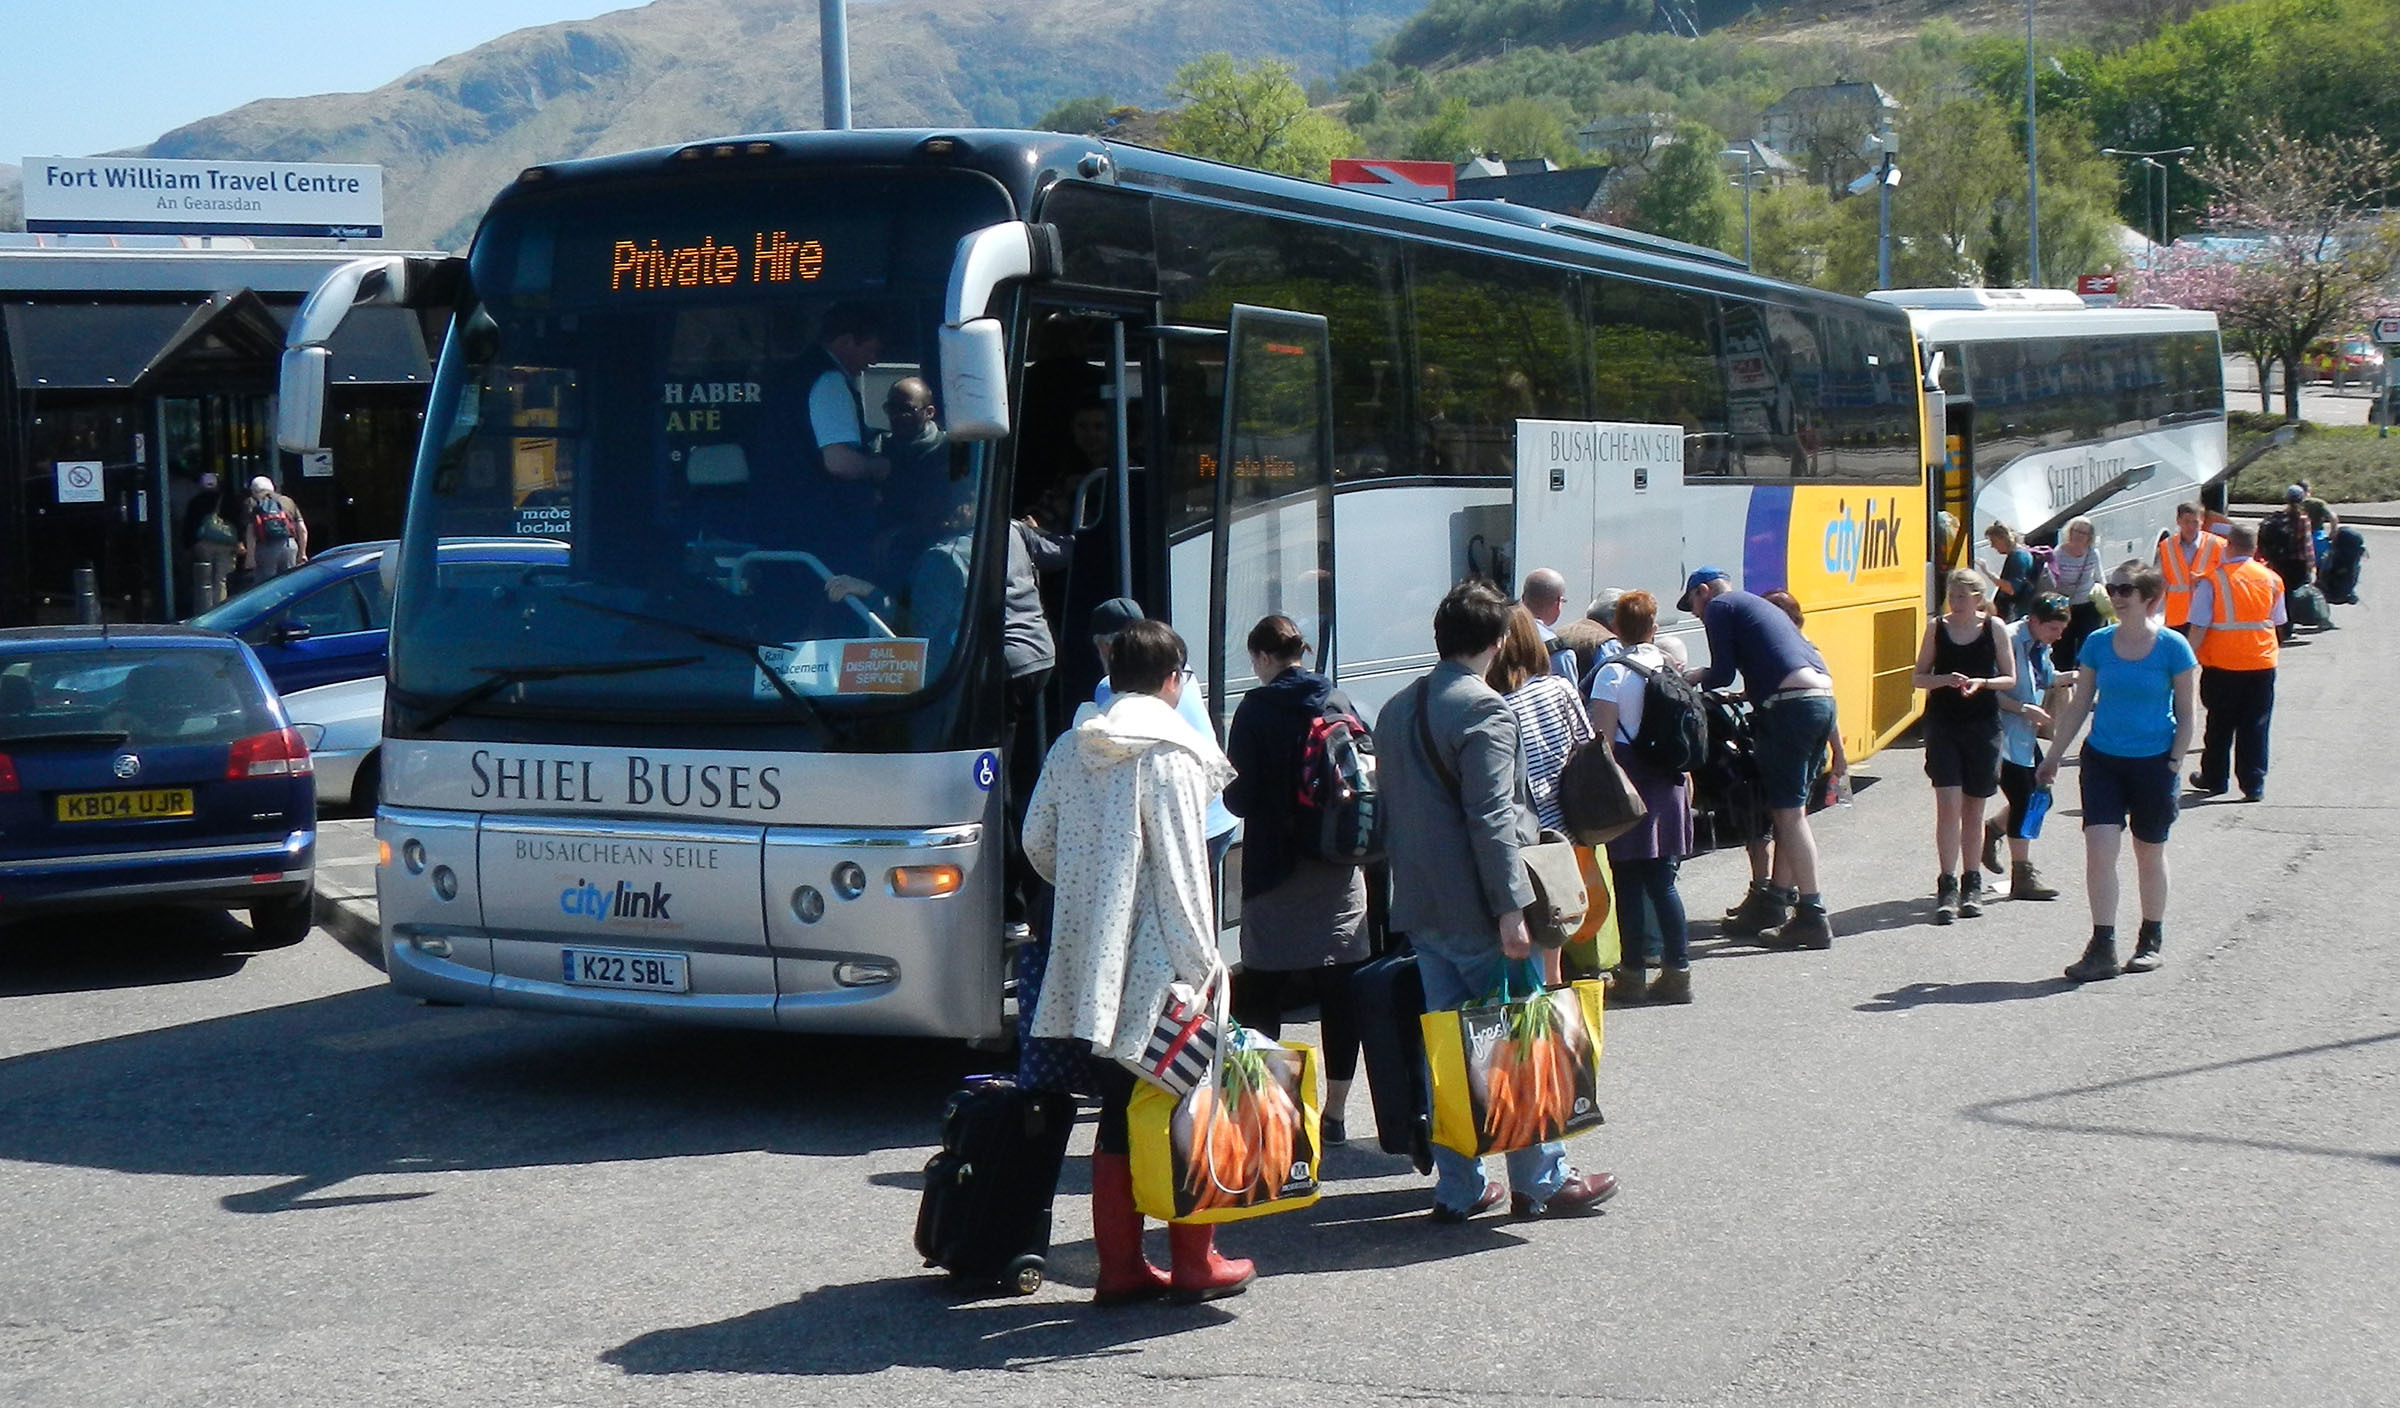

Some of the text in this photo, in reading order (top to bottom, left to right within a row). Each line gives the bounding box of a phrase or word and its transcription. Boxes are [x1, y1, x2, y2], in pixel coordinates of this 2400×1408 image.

[46, 166, 360, 193] Fort William Travel Centre
[157, 196, 262, 211] An Gearasdan
[611, 231, 822, 289] Private Hire
[1551, 430, 1651, 462] BUSAICHEAN
[522, 507, 571, 520] made
[1823, 497, 1902, 583] citylink
[764, 651, 784, 662] Rail
[845, 659, 919, 673] DISRUPTION
[869, 648, 896, 660] RAIL
[855, 672, 904, 685] SERVICE
[470, 750, 782, 810] SHIEL BUSES
[67, 792, 185, 818] KB04 UJR
[515, 839, 719, 870] BUSAICHEAN SEILE
[560, 878, 673, 922] citylink
[583, 956, 674, 986] K22 SBL
